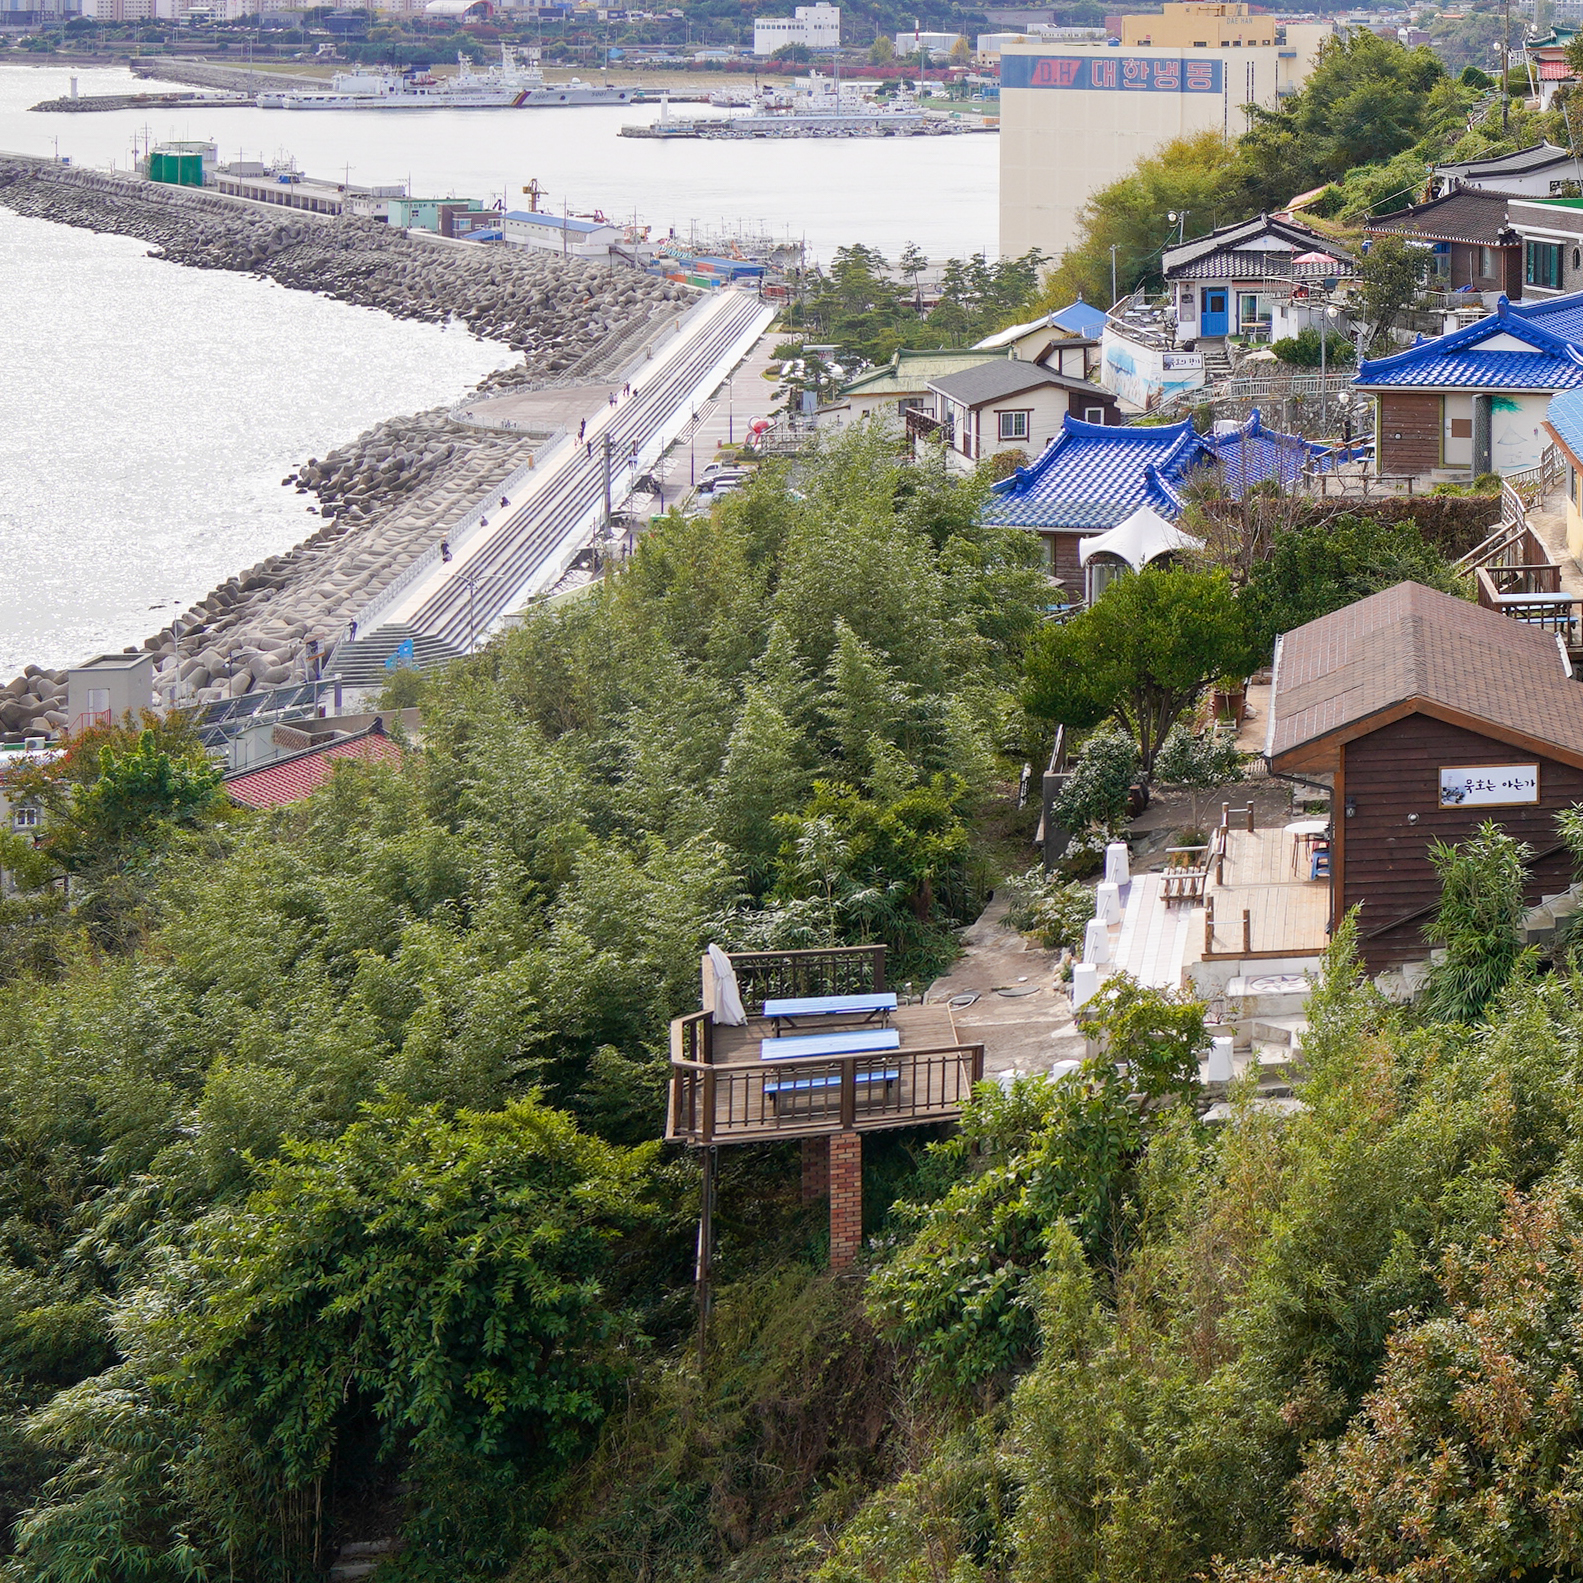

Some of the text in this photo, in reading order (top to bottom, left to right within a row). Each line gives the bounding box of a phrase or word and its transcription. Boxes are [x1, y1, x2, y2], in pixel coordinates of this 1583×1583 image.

[1226, 17, 1253, 25] DAE HAN
[1040, 61, 1073, 84] D.H
[1091, 58, 1213, 90] 대한냉동
[1464, 778, 1536, 794] 묵호는 아는가
